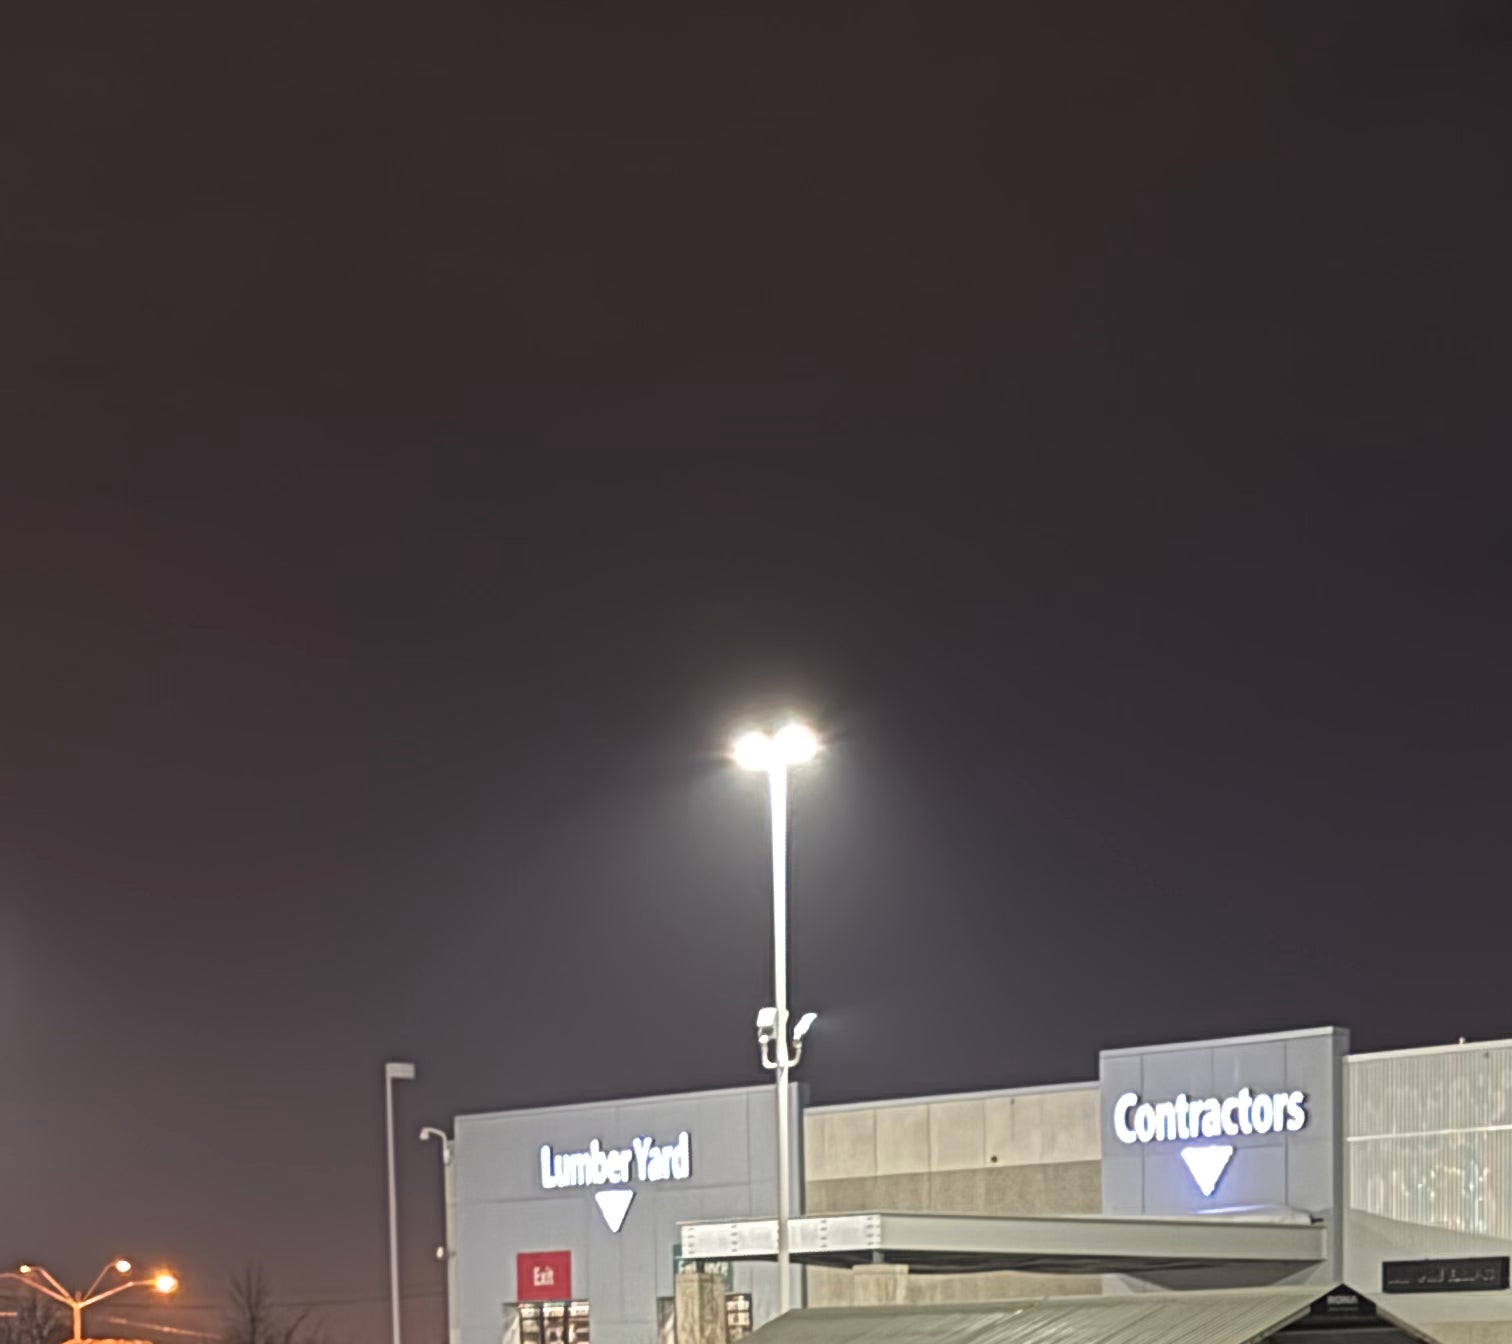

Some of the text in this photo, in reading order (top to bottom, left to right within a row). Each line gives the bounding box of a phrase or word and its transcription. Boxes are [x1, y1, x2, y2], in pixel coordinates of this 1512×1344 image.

[1114, 1087, 1306, 1143] Contractors
[540, 1131, 691, 1188] Lumber Yard
[533, 1266, 554, 1287] Exit
